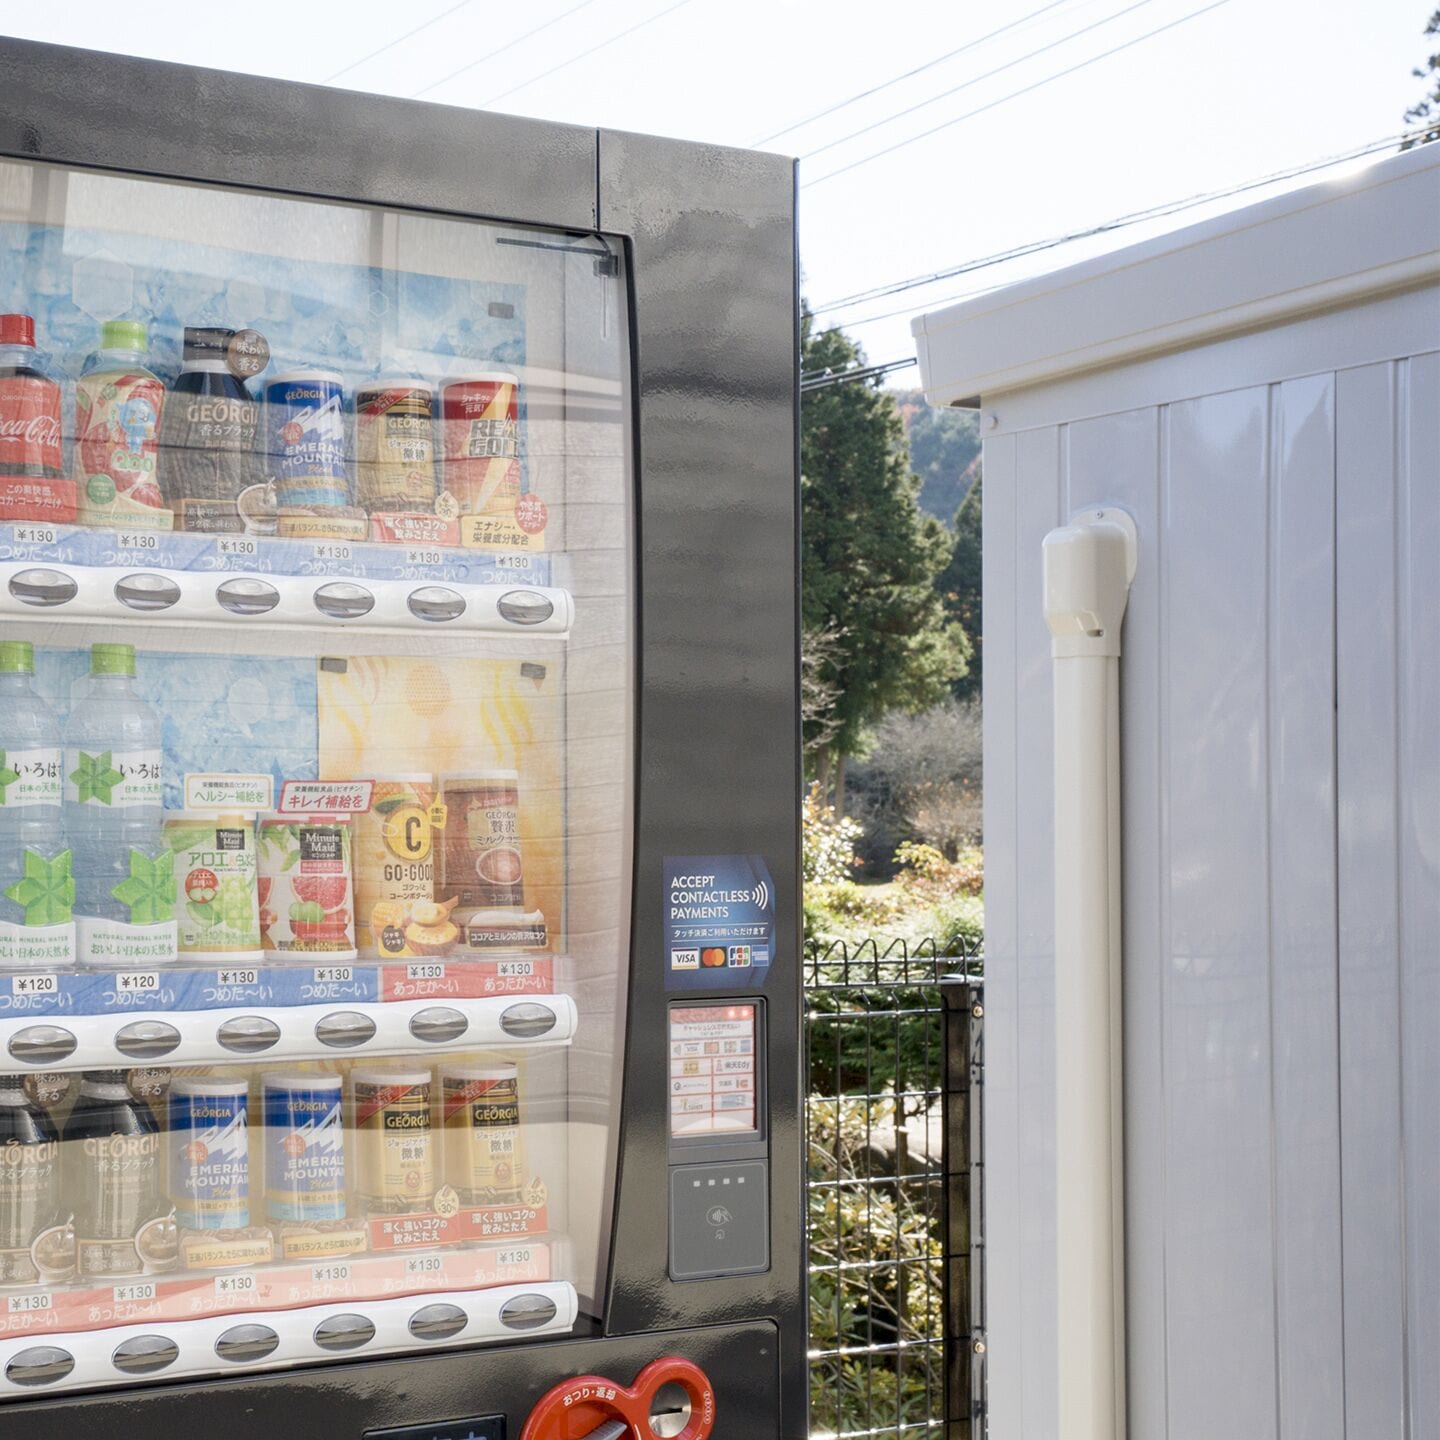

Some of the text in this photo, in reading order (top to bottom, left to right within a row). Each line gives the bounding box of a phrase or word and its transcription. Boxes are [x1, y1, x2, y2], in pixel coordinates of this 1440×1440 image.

[238, 359, 260, 371] 香る
[199, 424, 255, 438] 香るブラック
[16, 528, 54, 543] ¥130
[120, 535, 157, 549] ¥130
[471, 532, 530, 546] 栄養成分配合
[219, 540, 255, 554] ¥130
[317, 546, 350, 559] ¥130
[408, 551, 441, 564] ¥130
[497, 556, 529, 569] ¥130
[194, 789, 265, 803] ヘルシー補給を
[288, 795, 365, 809] キレイ補給を
[305, 832, 340, 844] Minute
[310, 841, 337, 853] Maid
[671, 875, 715, 889] ACCEPT
[671, 890, 750, 904] CONTACTLESS
[671, 906, 730, 919] PAYMENTS
[673, 926, 766, 938] タッチ決済ご利用いただけます
[90, 942, 175, 956] おいしい日本の天然水
[675, 953, 696, 963] VISA
[317, 967, 350, 981] ¥130
[410, 965, 443, 978] ¥130
[500, 963, 532, 975] ¥130
[17, 977, 53, 991] ¥120
[120, 975, 156, 988] ¥120
[220, 970, 256, 984] ¥130
[189, 1105, 231, 1118] GEORGIA
[474, 1106, 518, 1121] GEORGIA
[386, 1112, 430, 1128] GEORGIA
[95, 1156, 155, 1173] 香るブラック
[472, 1209, 537, 1225] 深く、強いコクの
[383, 1218, 448, 1234] 深く、強いコクの
[482, 1221, 529, 1235] 飲みごたえ
[393, 1231, 441, 1245] 飲みごたえ
[499, 1250, 531, 1263] ¥130
[408, 1258, 441, 1272] ¥130
[314, 1266, 349, 1281] ¥130
[219, 1276, 253, 1291] ¥130
[116, 1286, 153, 1300] ¥130
[11, 1296, 49, 1311] ¥130
[562, 1386, 617, 1407] おつり・返却
